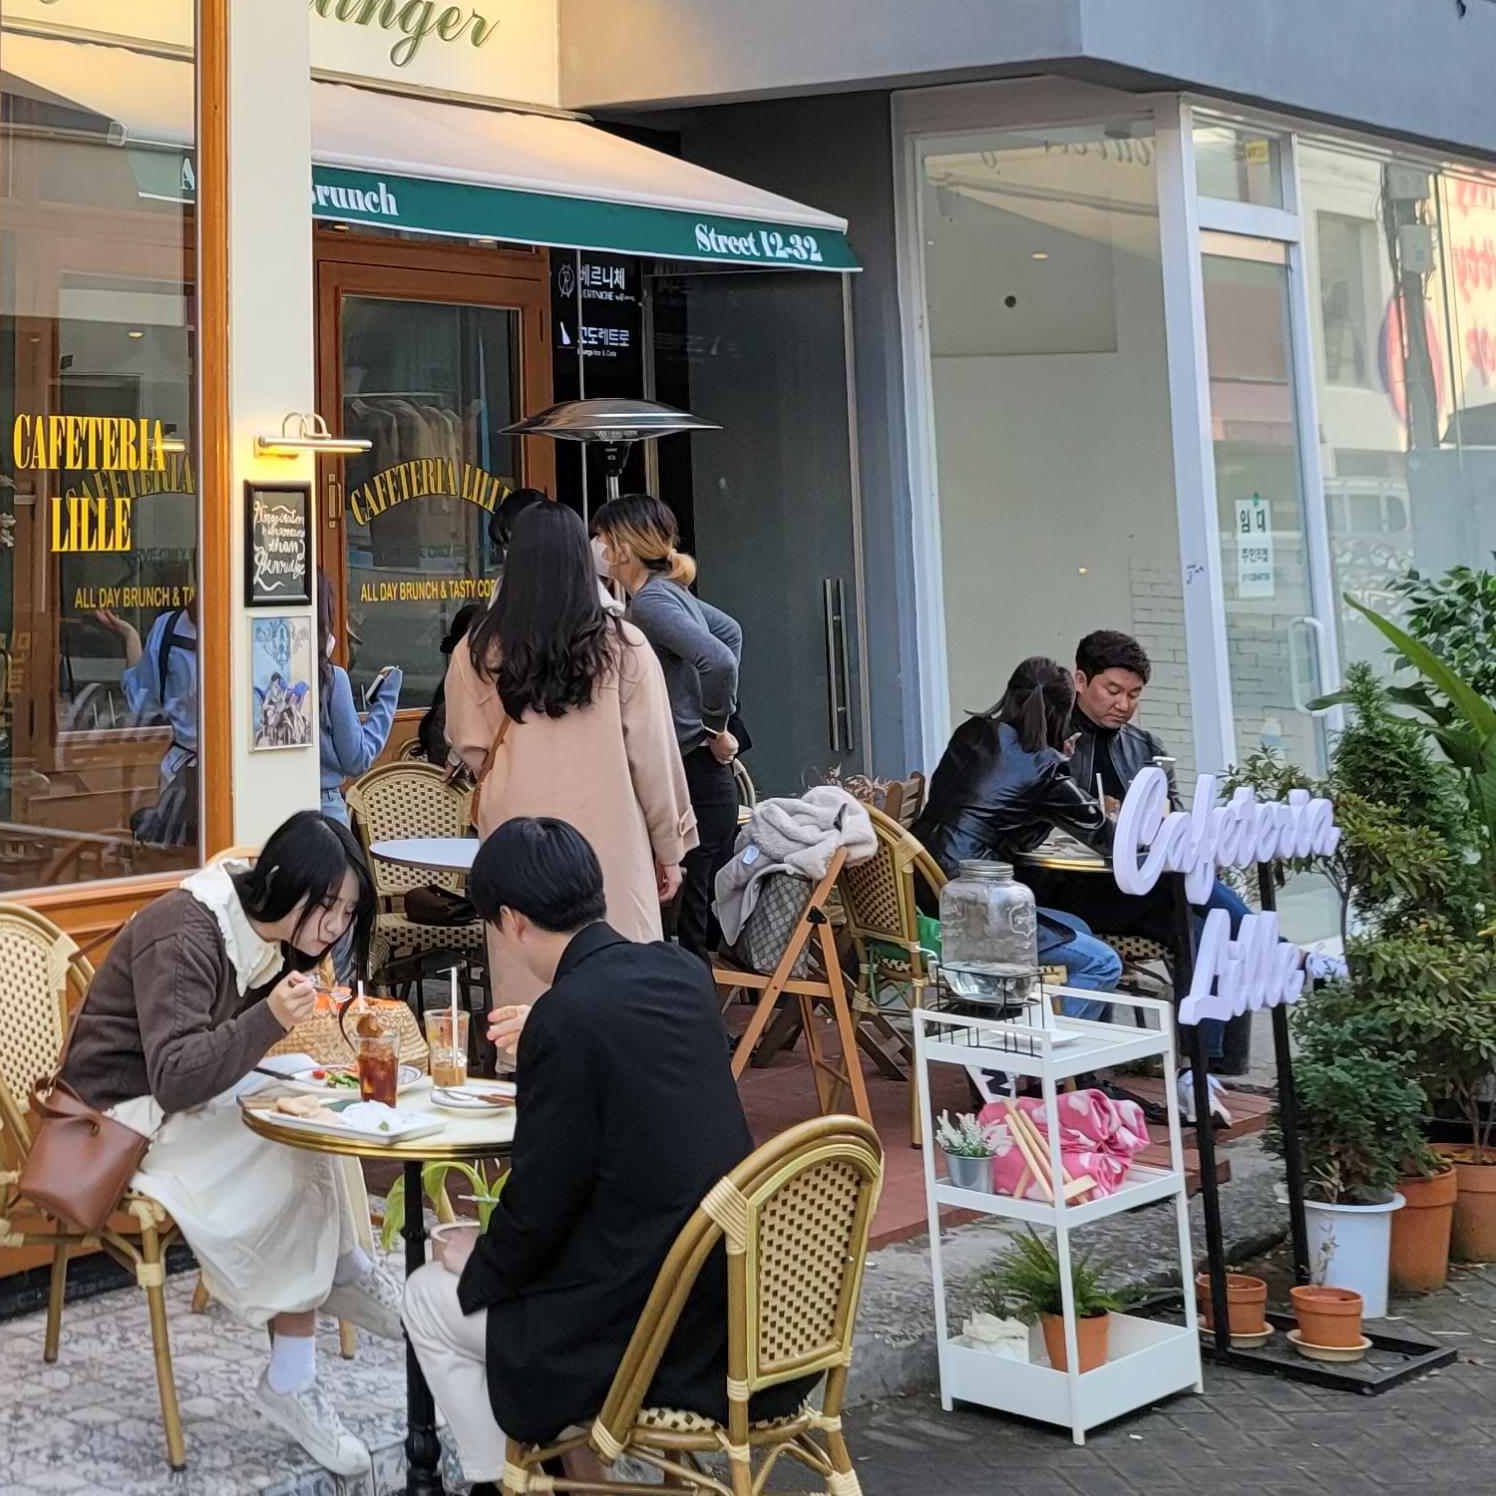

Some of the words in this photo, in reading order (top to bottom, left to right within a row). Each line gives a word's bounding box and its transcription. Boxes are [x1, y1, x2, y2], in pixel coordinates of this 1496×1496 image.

[312, 181, 400, 216] runch
[695, 223, 761, 257] Street
[759, 230, 824, 263] 12-32
[13, 413, 166, 472] CAFETERIA
[350, 457, 458, 526] CAFETERIA
[51, 497, 132, 553] LILLE
[75, 587, 98, 609] ALL
[98, 587, 121, 608] DAY
[123, 586, 170, 608] BRUNCH
[172, 586, 181, 606] &
[361, 582, 378, 602] ALL
[380, 581, 399, 601] DAY
[399, 581, 439, 602] BRUNCH
[440, 580, 448, 600] &
[449, 579, 477, 600] TASTY
[1113, 766, 1341, 905] Cafeteria
[1178, 908, 1306, 1026] Lille
